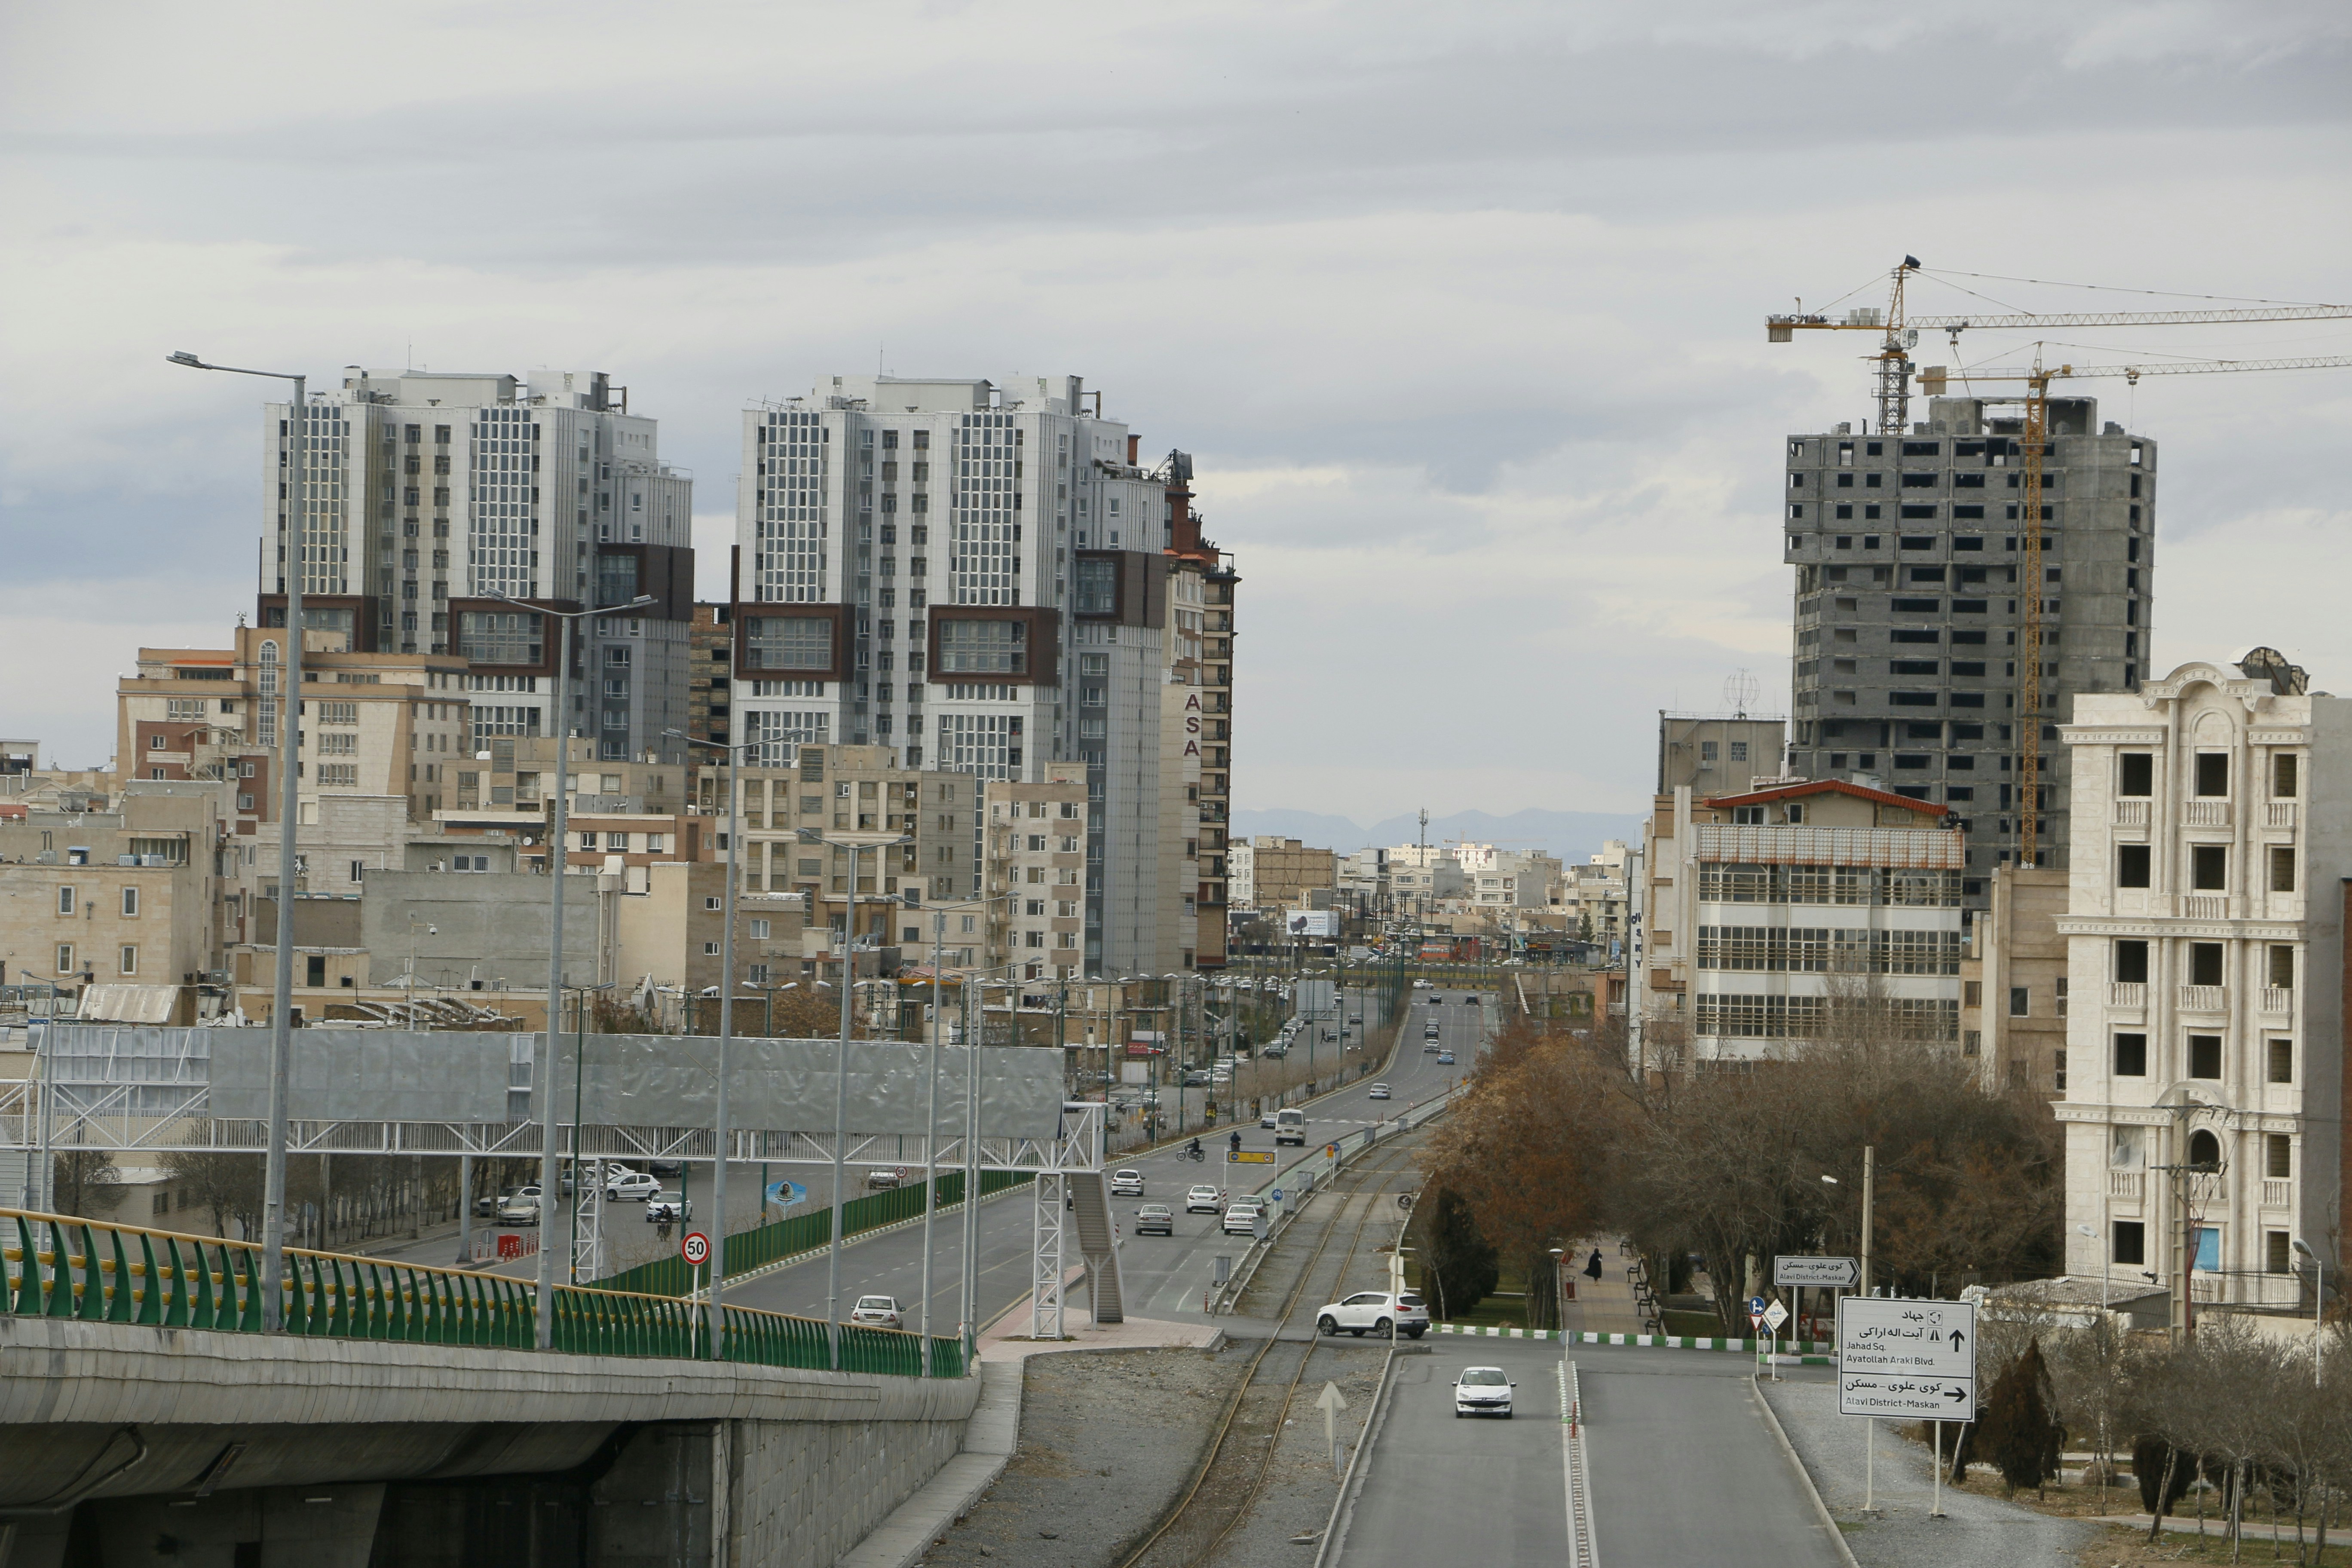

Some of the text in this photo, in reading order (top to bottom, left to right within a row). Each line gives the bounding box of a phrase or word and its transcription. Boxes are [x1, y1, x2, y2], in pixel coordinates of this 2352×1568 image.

[1184, 694, 1200, 756] ASA
[687, 1241, 704, 1255] 50
[1828, 1263, 1844, 1271] کوی
[1902, 1311, 1924, 1322] جهاد
[1859, 1327, 1924, 1340] آیت اله اراکی
[1847, 1341, 1886, 1351] Jahad Sq.
[1847, 1354, 1935, 1366] Ayatollah Araki Blvd.
[1846, 1379, 1877, 1391] مسکن
[1888, 1381, 1915, 1393] علوی
[1920, 1383, 1942, 1395] کوی
[1846, 1397, 1940, 1409] Alavi District-Maskan
